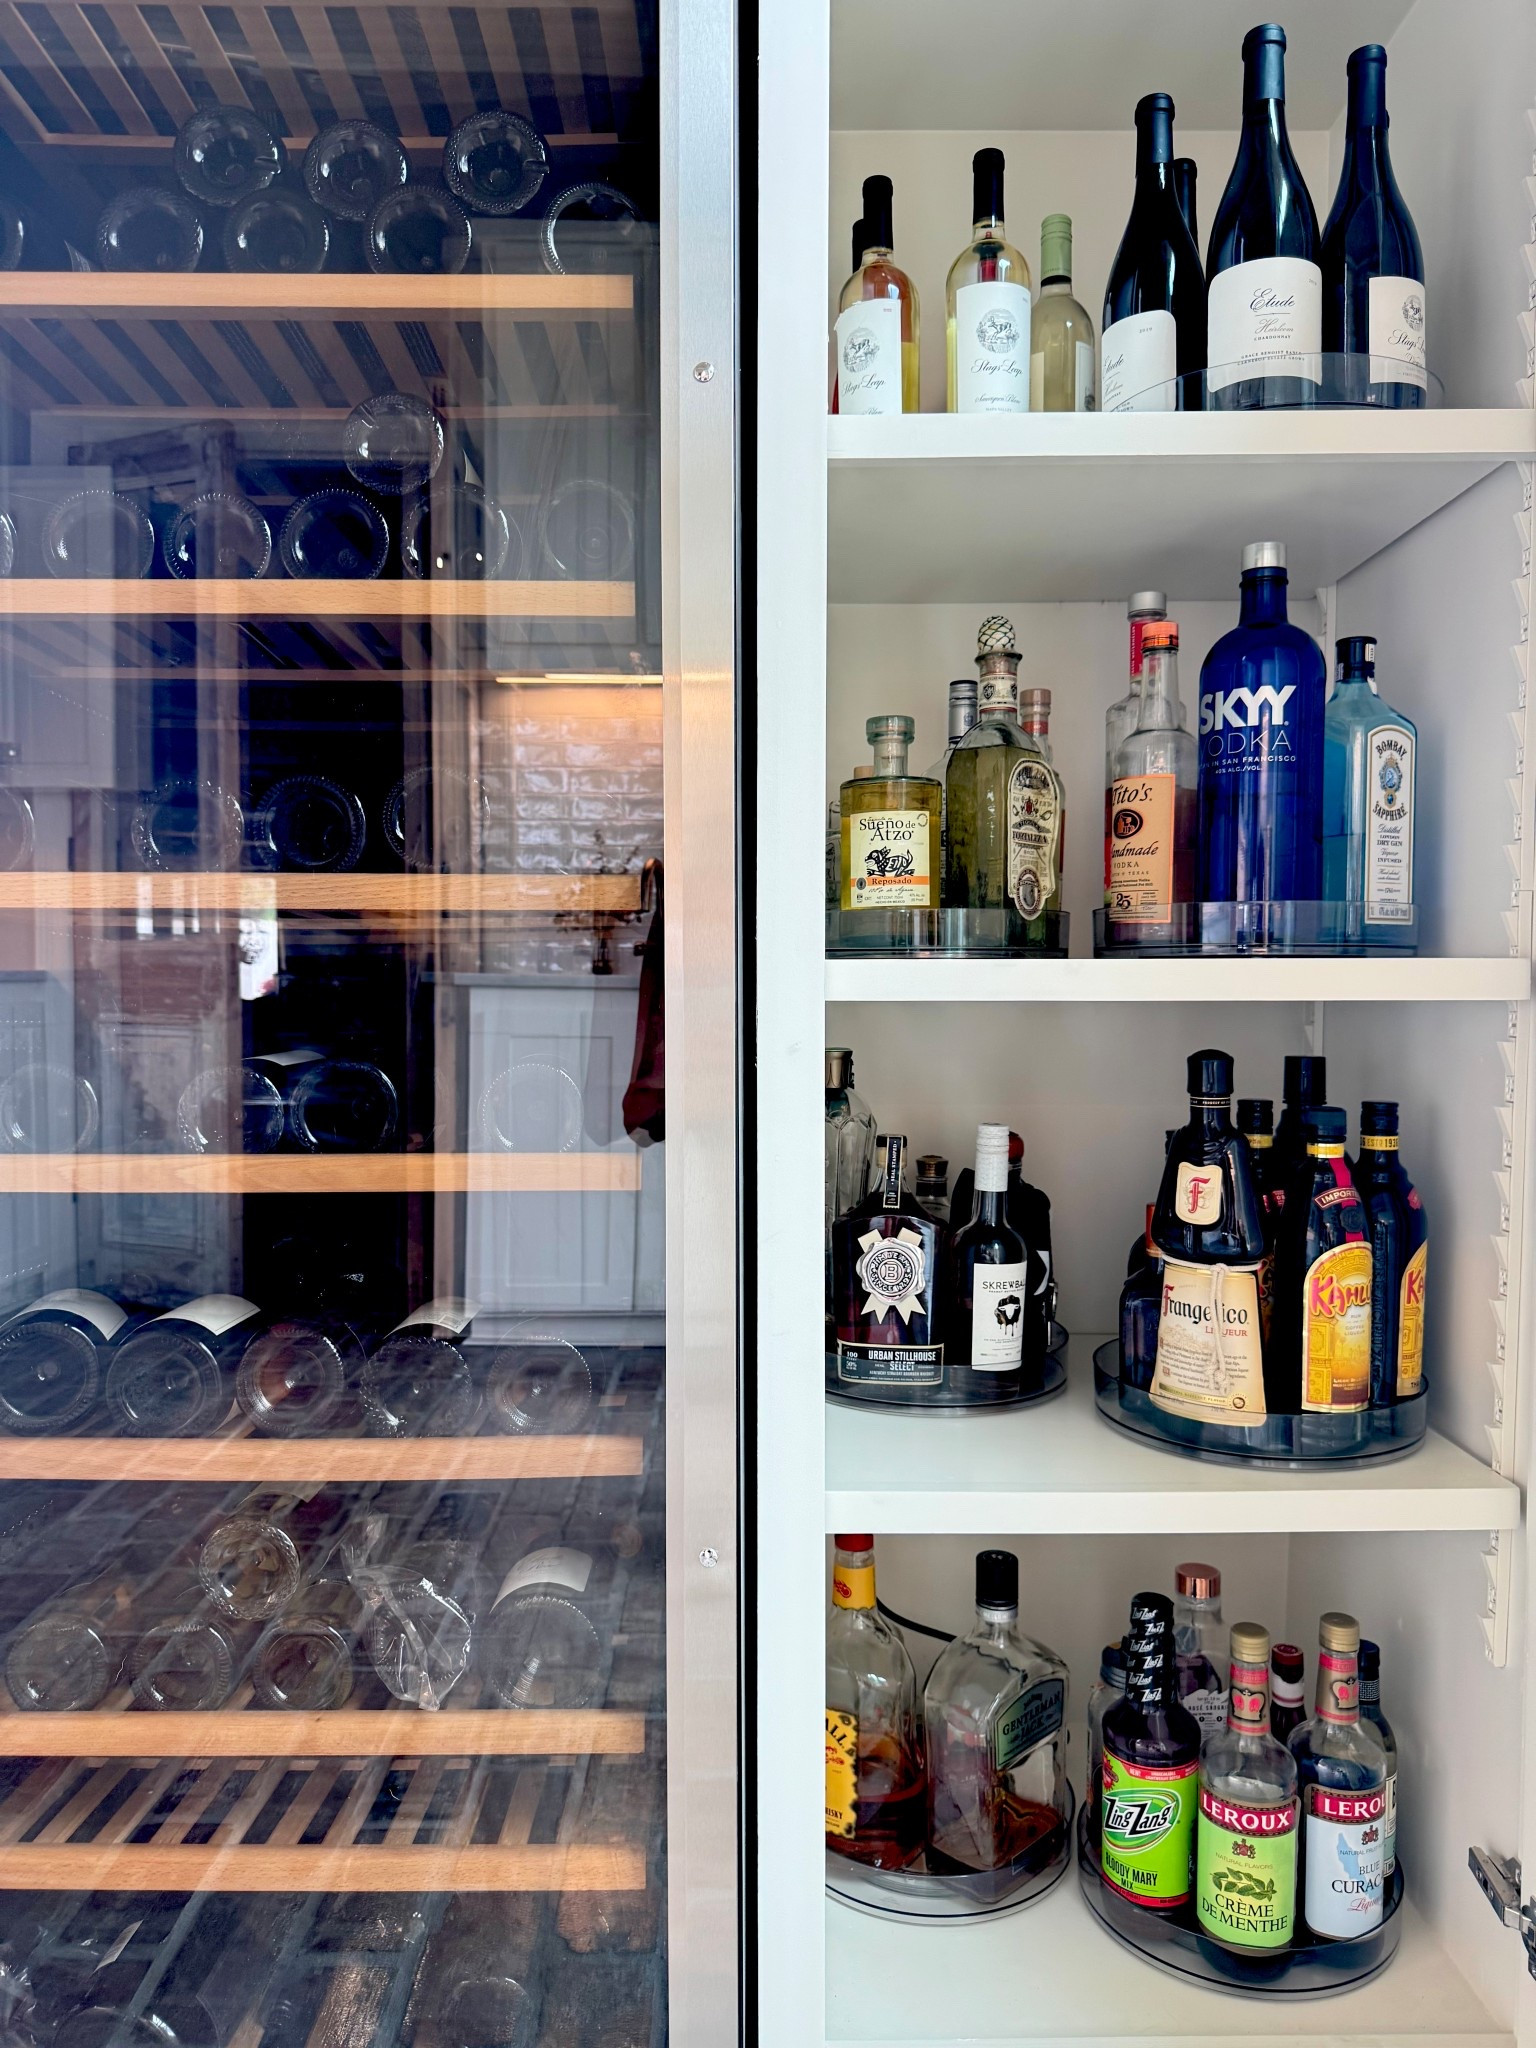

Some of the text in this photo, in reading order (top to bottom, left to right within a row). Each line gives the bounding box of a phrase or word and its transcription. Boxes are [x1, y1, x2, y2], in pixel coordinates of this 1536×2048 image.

[1249, 287, 1296, 313] Etude
[1254, 318, 1295, 335] Heirloom
[1253, 334, 1292, 342] CHARDONNAY
[1001, 359, 1023, 378] Leap
[861, 373, 886, 390] Leap
[1200, 685, 1297, 735] SKYY
[1375, 739, 1408, 760] BOMBAY
[1221, 758, 1239, 767] SAN
[1242, 755, 1297, 764] FRANCISCO
[1112, 782, 1152, 808] Tito's
[1372, 802, 1408, 821] SAPPHIRE
[870, 826, 912, 841] Atzo
[905, 820, 916, 829] de
[871, 877, 912, 886] Reposado
[1116, 893, 1133, 910] 25
[1188, 1176, 1211, 1214] F
[884, 1263, 899, 1281] B
[1162, 1284, 1250, 1325] Frangeico
[1205, 1325, 1248, 1337] LIUEUR
[868, 1350, 936, 1361] URBAN STILLHOUSE
[889, 1361, 915, 1371] SELECT
[1002, 1690, 1061, 1736] GENTLEMAN
[1020, 1715, 1046, 1737] JACK
[1203, 1792, 1291, 1831] LEROUX
[1215, 1852, 1274, 1871] NATURAL FLAVORS
[1340, 1849, 1365, 1857] NATURAL
[1105, 1851, 1158, 1886] BLOODY MARY
[1359, 1859, 1381, 1876] BLUE
[1120, 1877, 1134, 1891] MIX
[1202, 1895, 1218, 1919] DE
[1218, 1909, 1288, 1933] MENTHE
[1215, 1893, 1274, 1918] CRÈME
